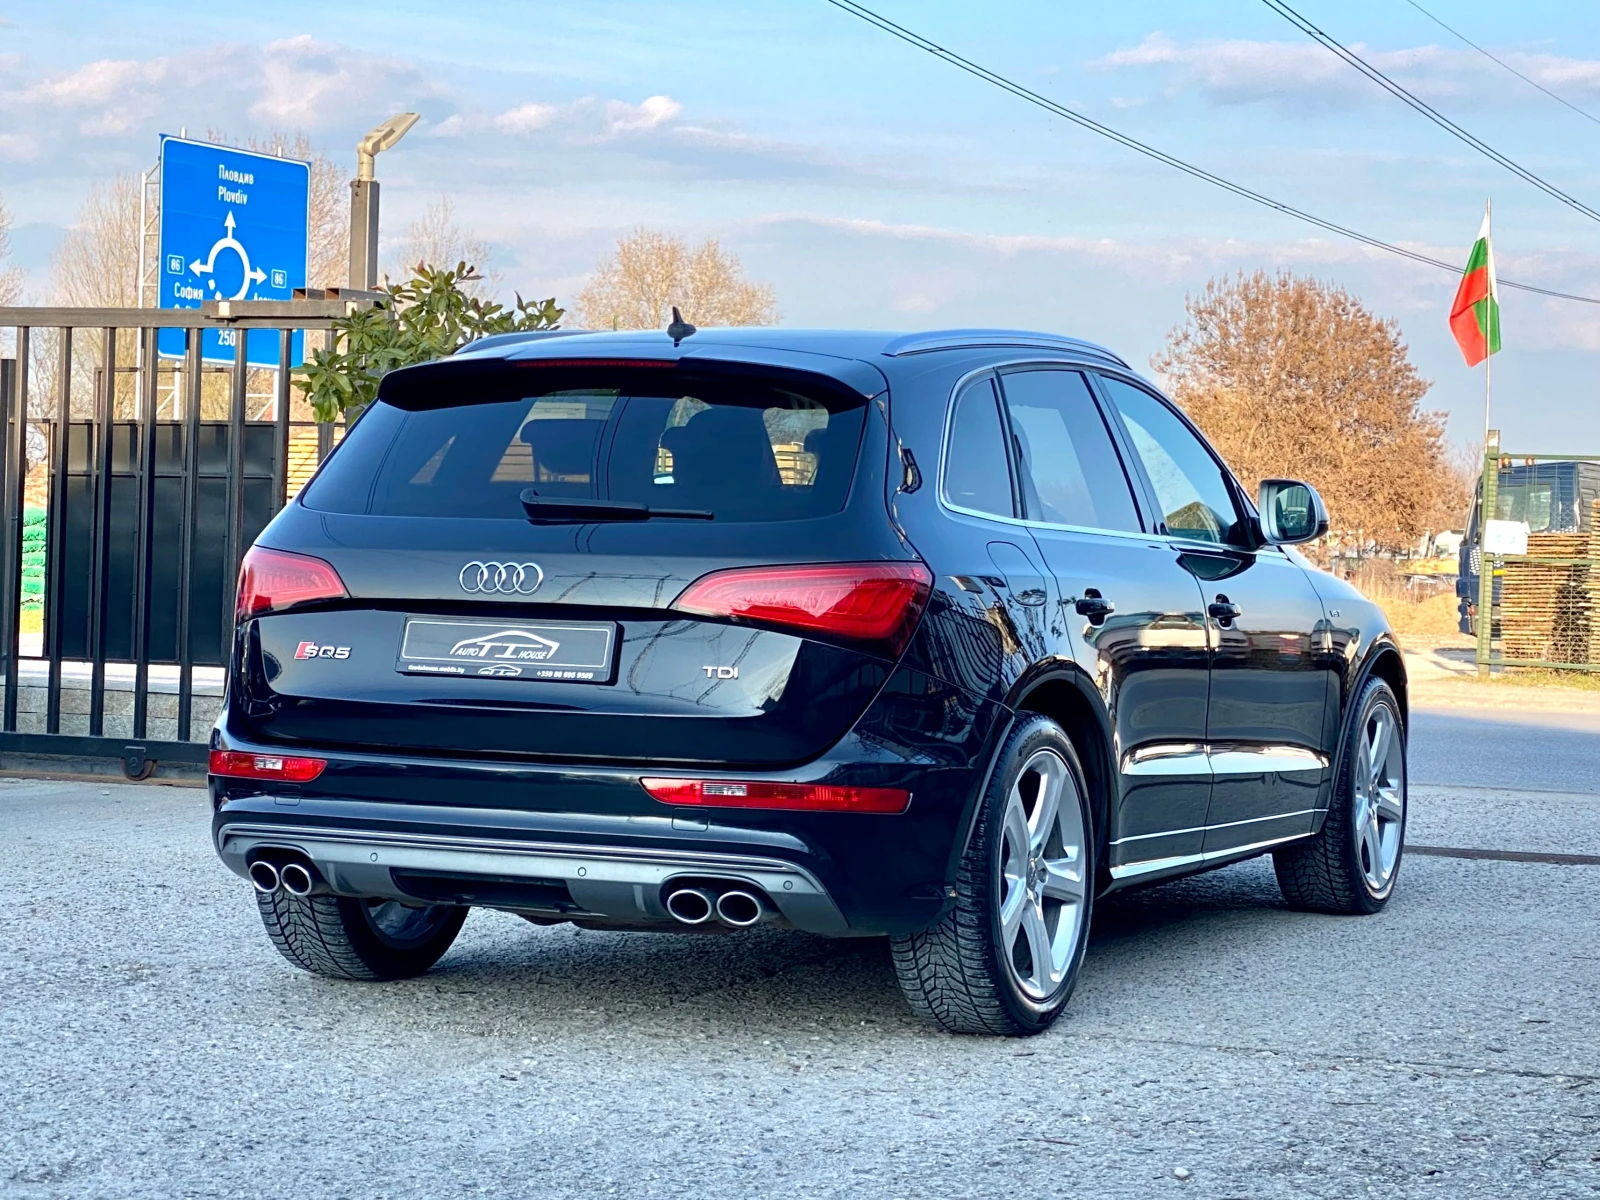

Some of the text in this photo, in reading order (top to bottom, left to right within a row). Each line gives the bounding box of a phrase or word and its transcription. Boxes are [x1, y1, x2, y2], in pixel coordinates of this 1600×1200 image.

[218, 163, 254, 185] Пловдив
[218, 185, 248, 205] Plovdiv
[170, 258, 181, 271] 86
[274, 272, 284, 285] 86
[174, 281, 204, 300] София
[301, 645, 351, 659] SQ5
[454, 647, 479, 656] AUTO
[517, 650, 547, 659] HOUSE
[701, 665, 739, 679] TDI
